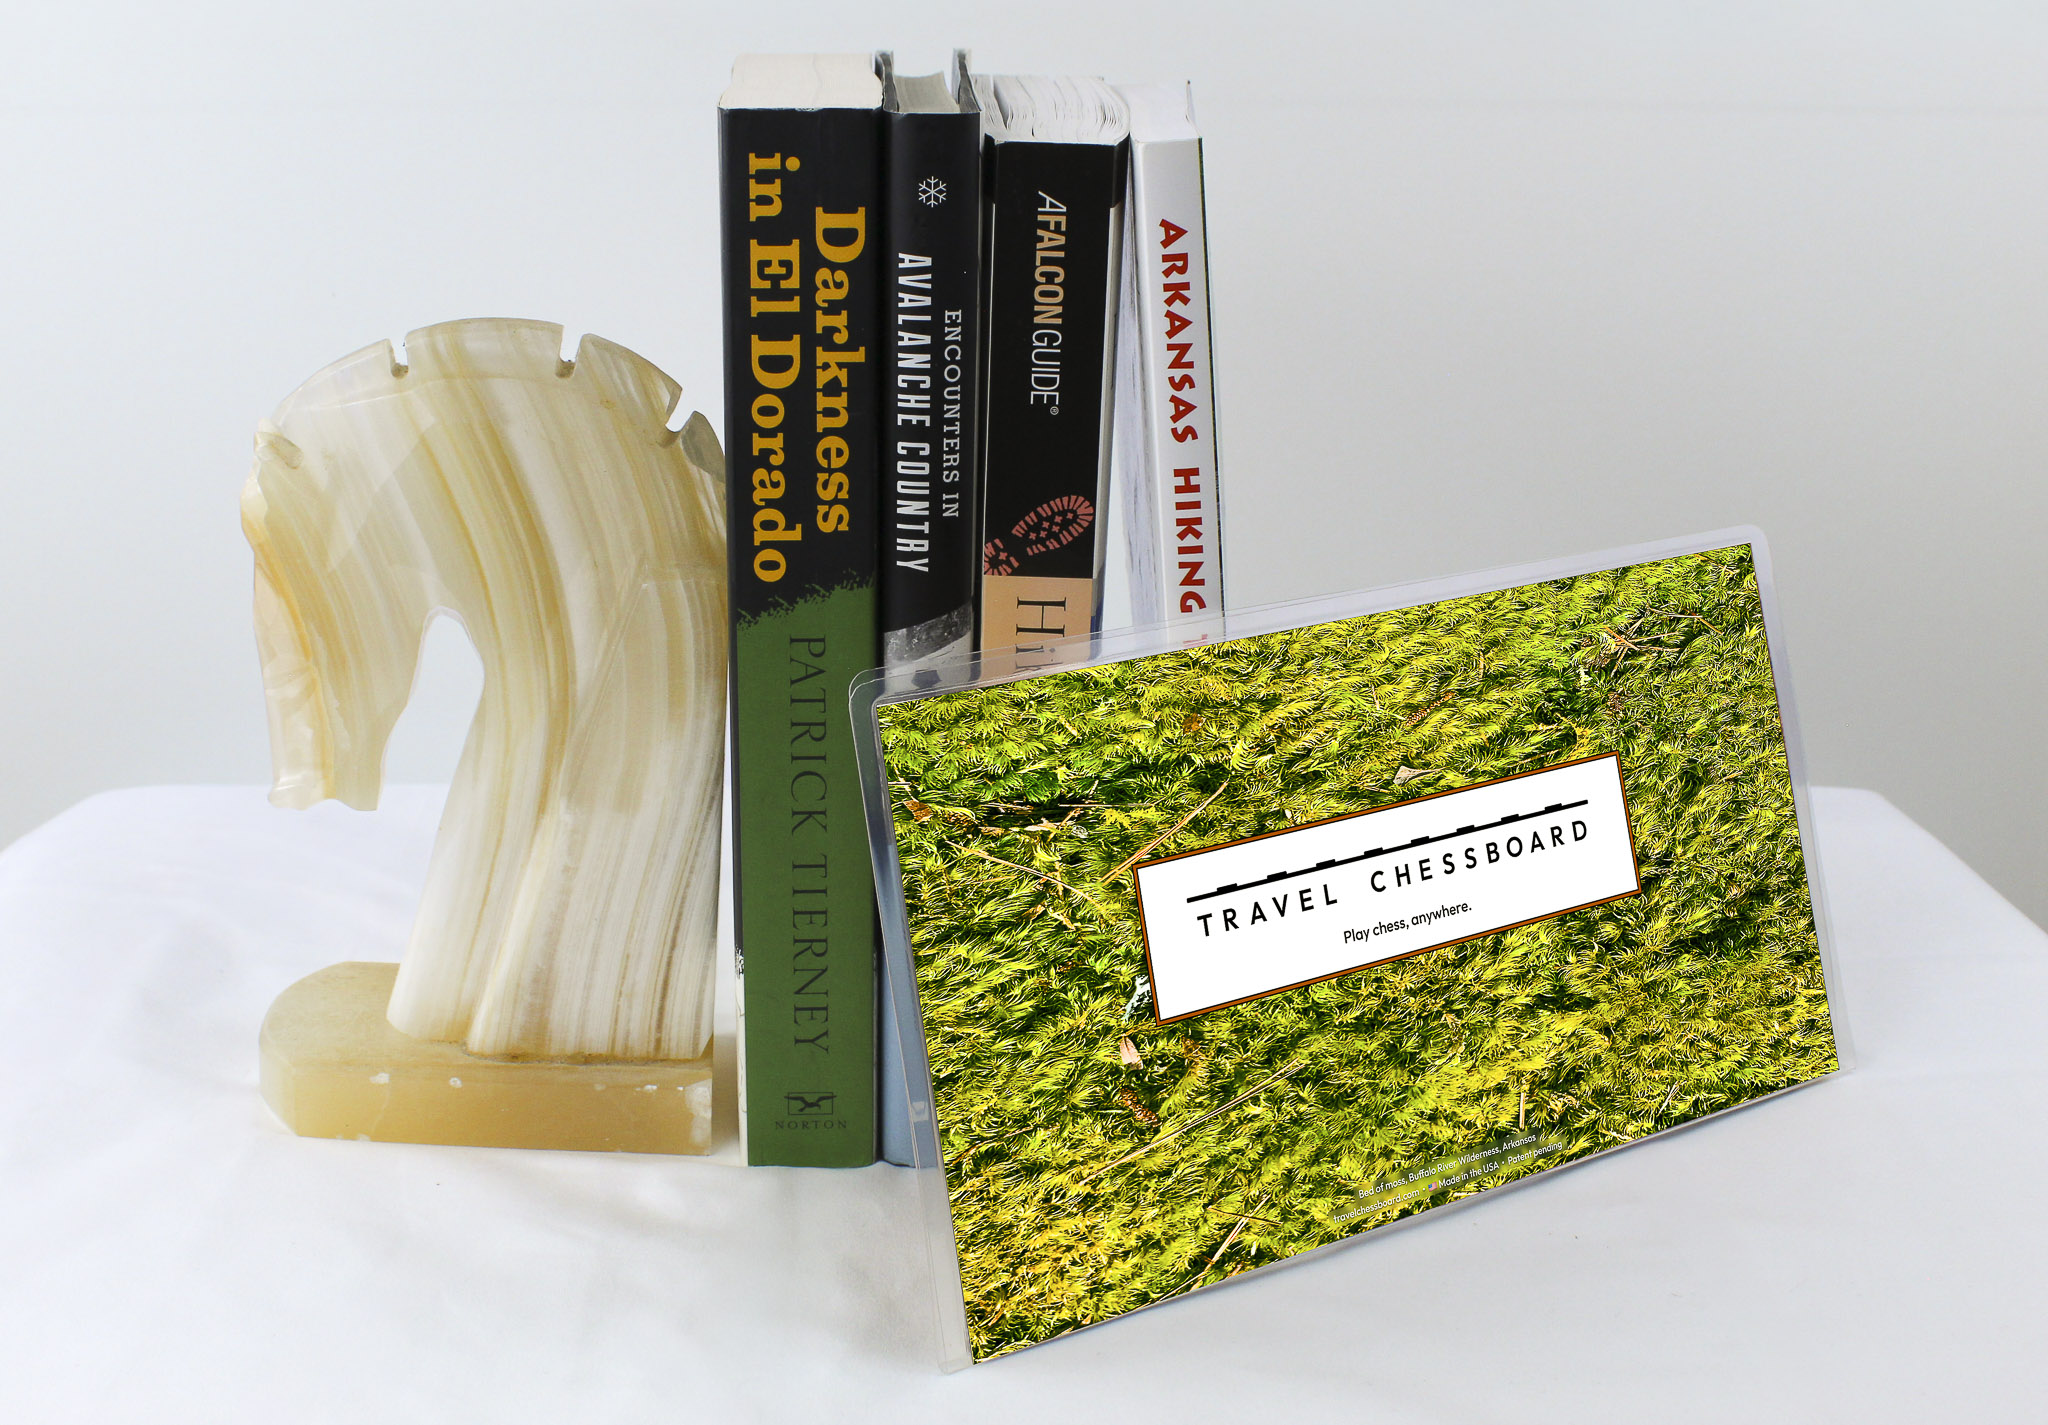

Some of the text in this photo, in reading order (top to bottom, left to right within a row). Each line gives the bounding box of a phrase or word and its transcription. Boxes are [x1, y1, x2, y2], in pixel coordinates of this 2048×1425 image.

[748, 152, 802, 583] in El Dorado
[814, 206, 866, 533] Darkness
[896, 252, 932, 572] AVALANCHE COUNTRY
[942, 309, 962, 518] ENCOUNTERS IN
[1159, 218, 1198, 443] ARKANSAS
[1173, 467, 1207, 613] HIKING
[788, 634, 829, 1055] PATRICK TIERNEY
[1196, 820, 1588, 937] TRAVEL CHESSBOARD
[1343, 902, 1472, 944] Play chess, anywhere.
[775, 1120, 847, 1130] NORTON
[1333, 1141, 1563, 1224] travelchessboard.com Made in the USA Patent pending
[1358, 1134, 1537, 1199] Bed of moss, Buffalo River Wilderness, Arkansas
